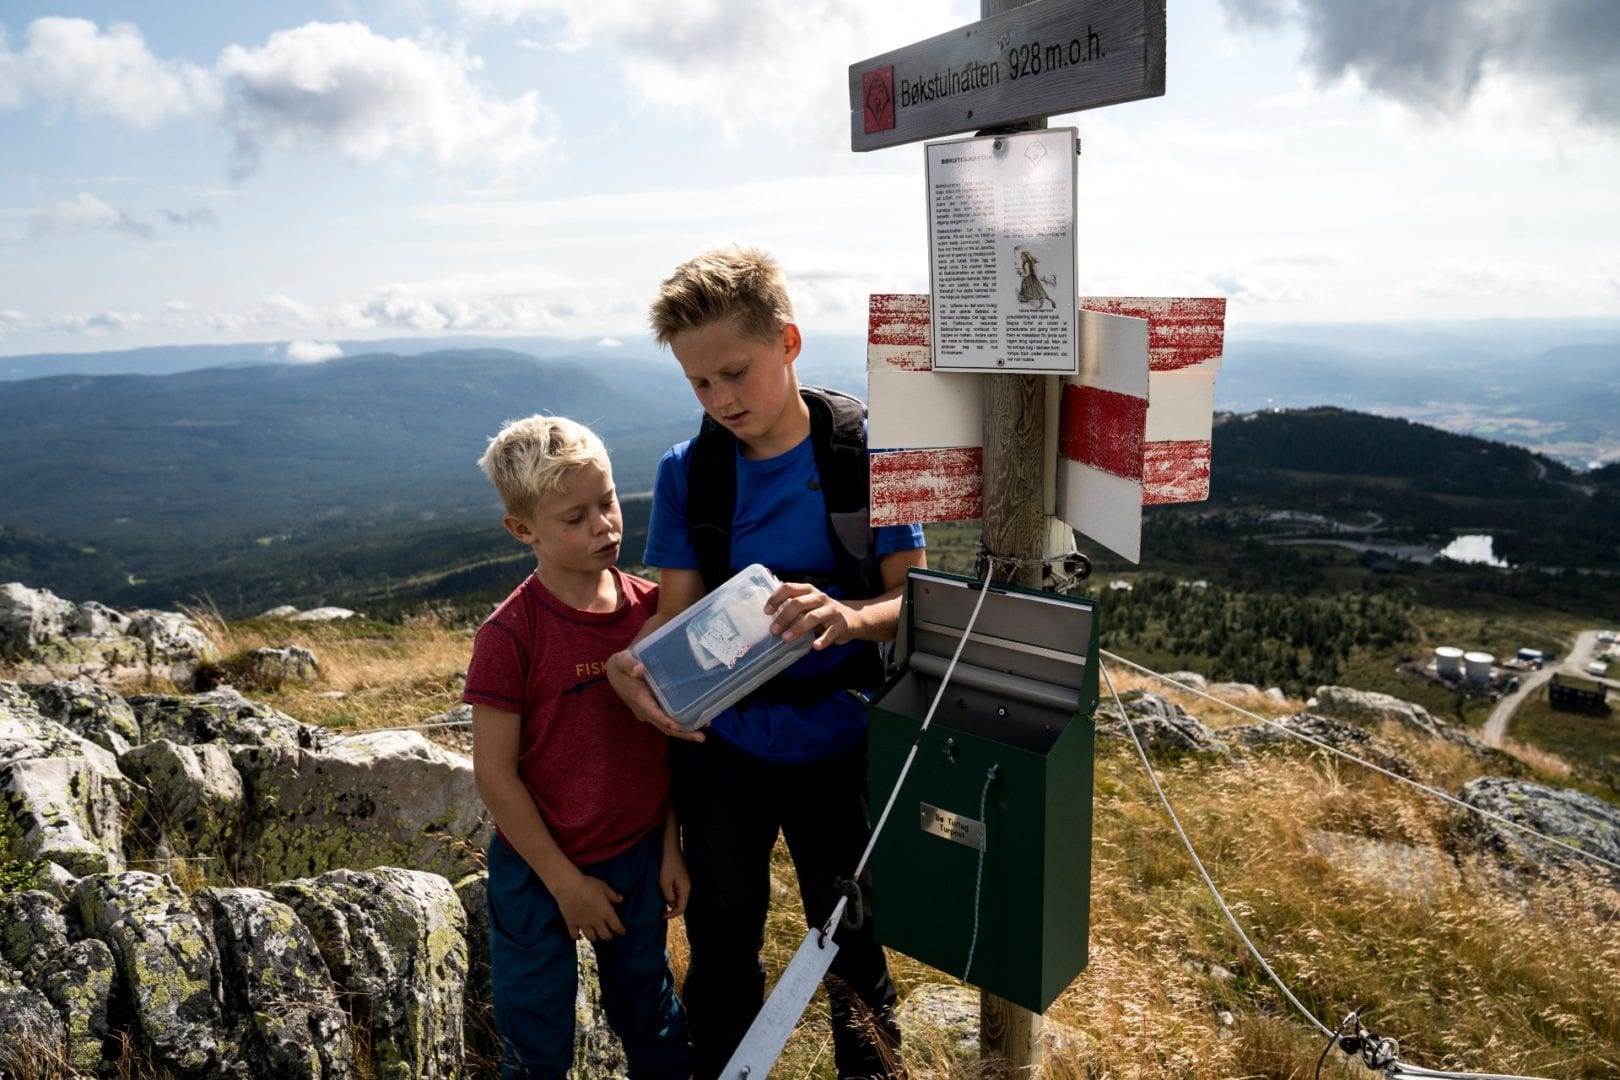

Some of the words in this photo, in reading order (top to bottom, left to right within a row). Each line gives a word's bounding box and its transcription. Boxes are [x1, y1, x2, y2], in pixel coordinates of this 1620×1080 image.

[1009, 41, 1041, 80] 928
[940, 824, 964, 839] Turpost
[948, 817, 968, 833] Turlag
